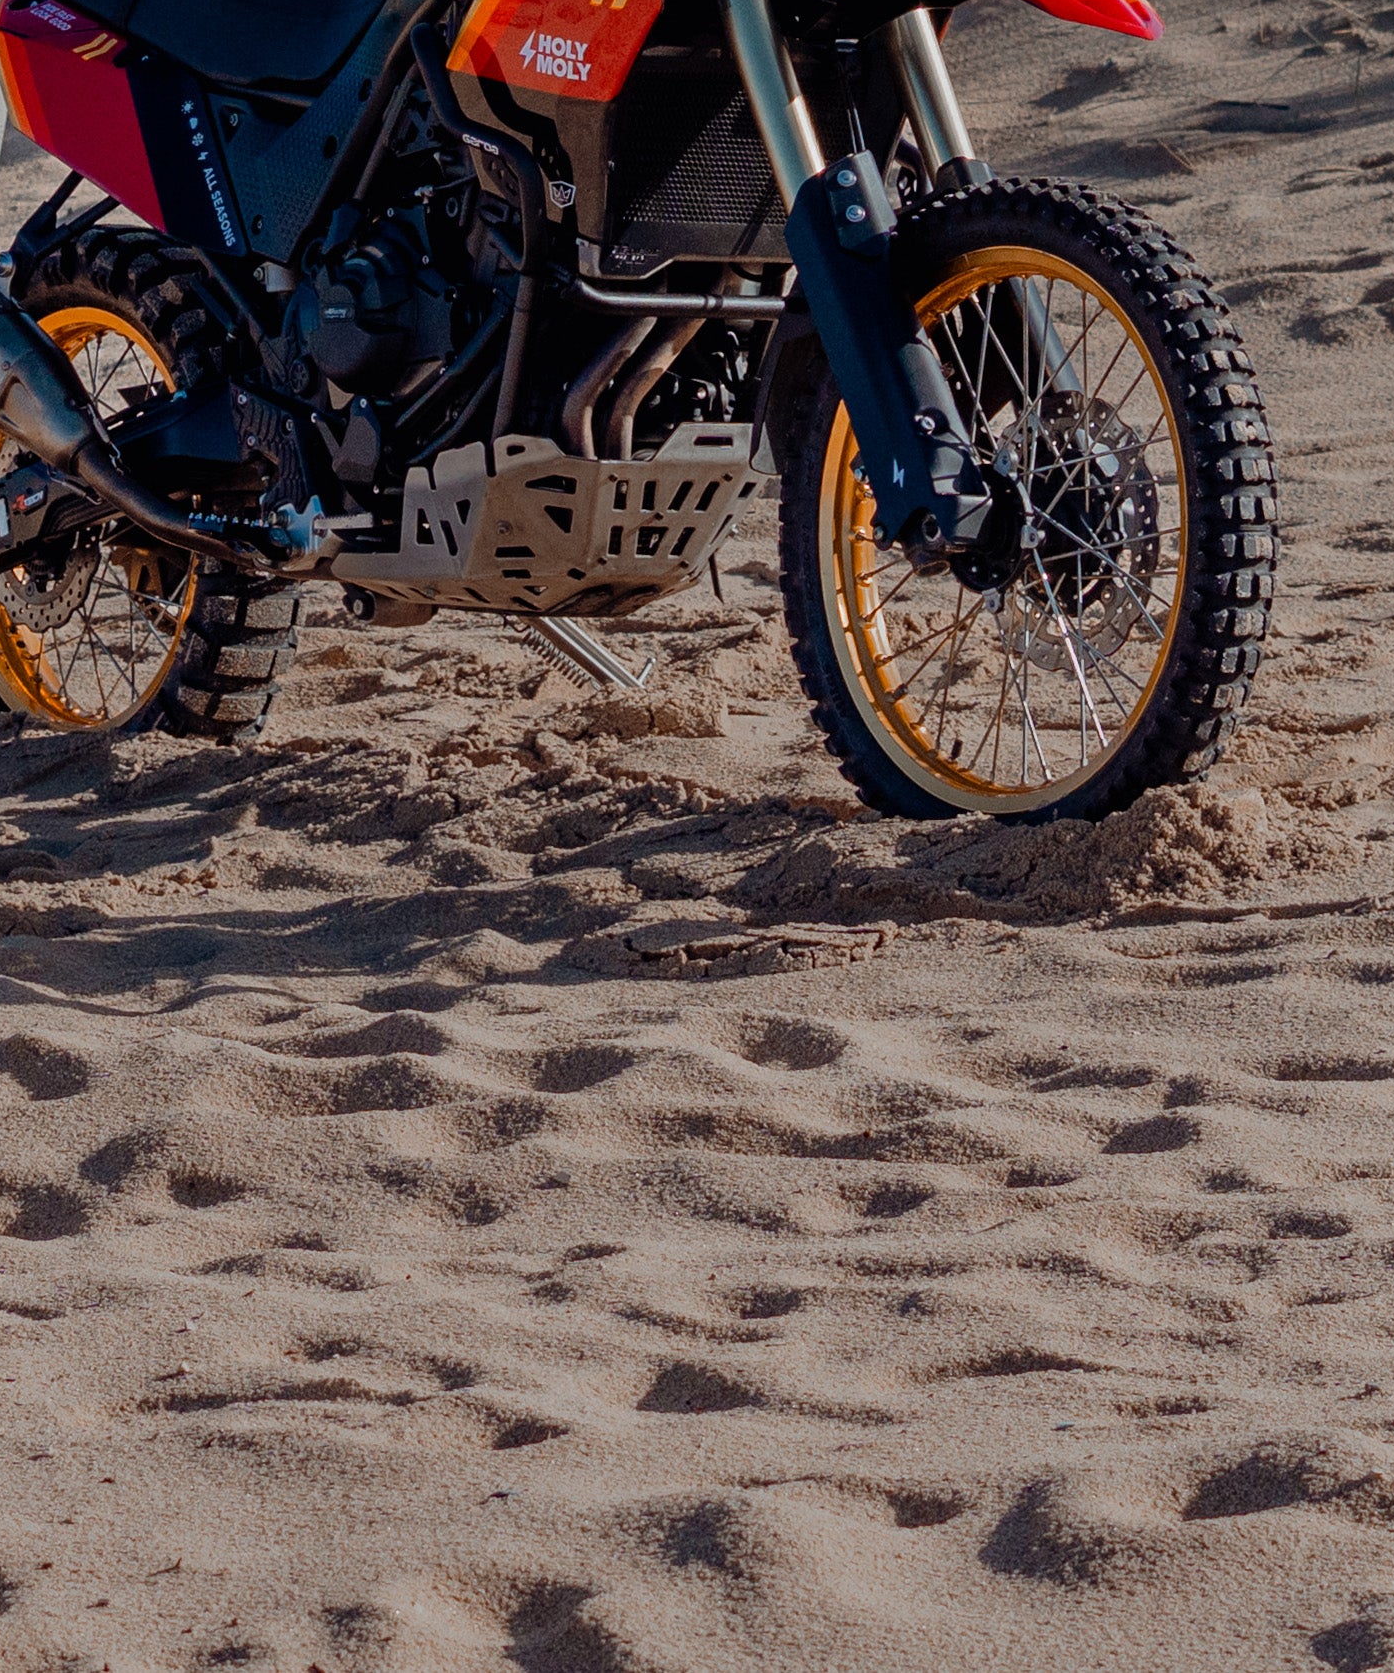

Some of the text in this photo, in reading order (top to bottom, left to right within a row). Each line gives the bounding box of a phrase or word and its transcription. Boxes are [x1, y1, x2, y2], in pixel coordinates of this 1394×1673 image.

[538, 33, 589, 61] HOLY
[536, 53, 592, 82] MOLY
[203, 167, 236, 247] ALL SEASONS
